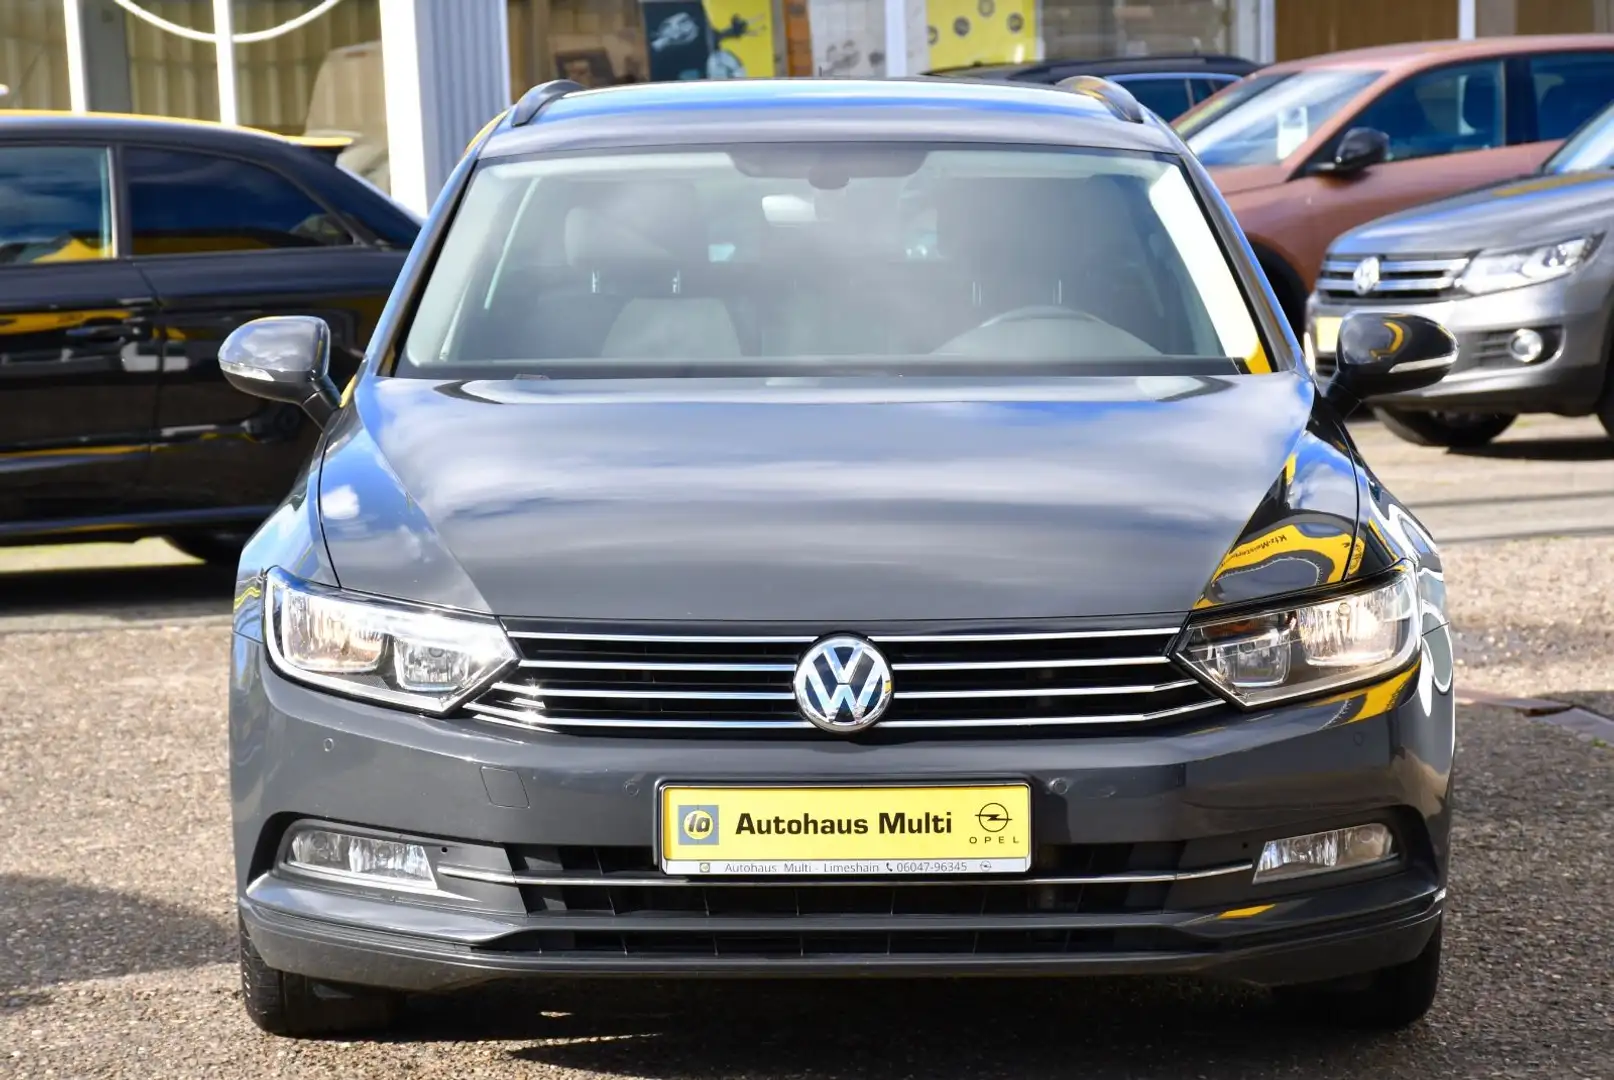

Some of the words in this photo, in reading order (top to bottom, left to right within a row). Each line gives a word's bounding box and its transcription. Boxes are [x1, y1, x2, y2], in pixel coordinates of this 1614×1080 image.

[735, 812, 869, 835] Autohaus
[878, 811, 952, 834] Multi
[969, 836, 1019, 844] OPEL
[724, 862, 777, 873] Autohaus
[783, 862, 812, 873] Multi
[823, 861, 879, 873] Limeshain
[896, 861, 968, 873] 06047-96345
